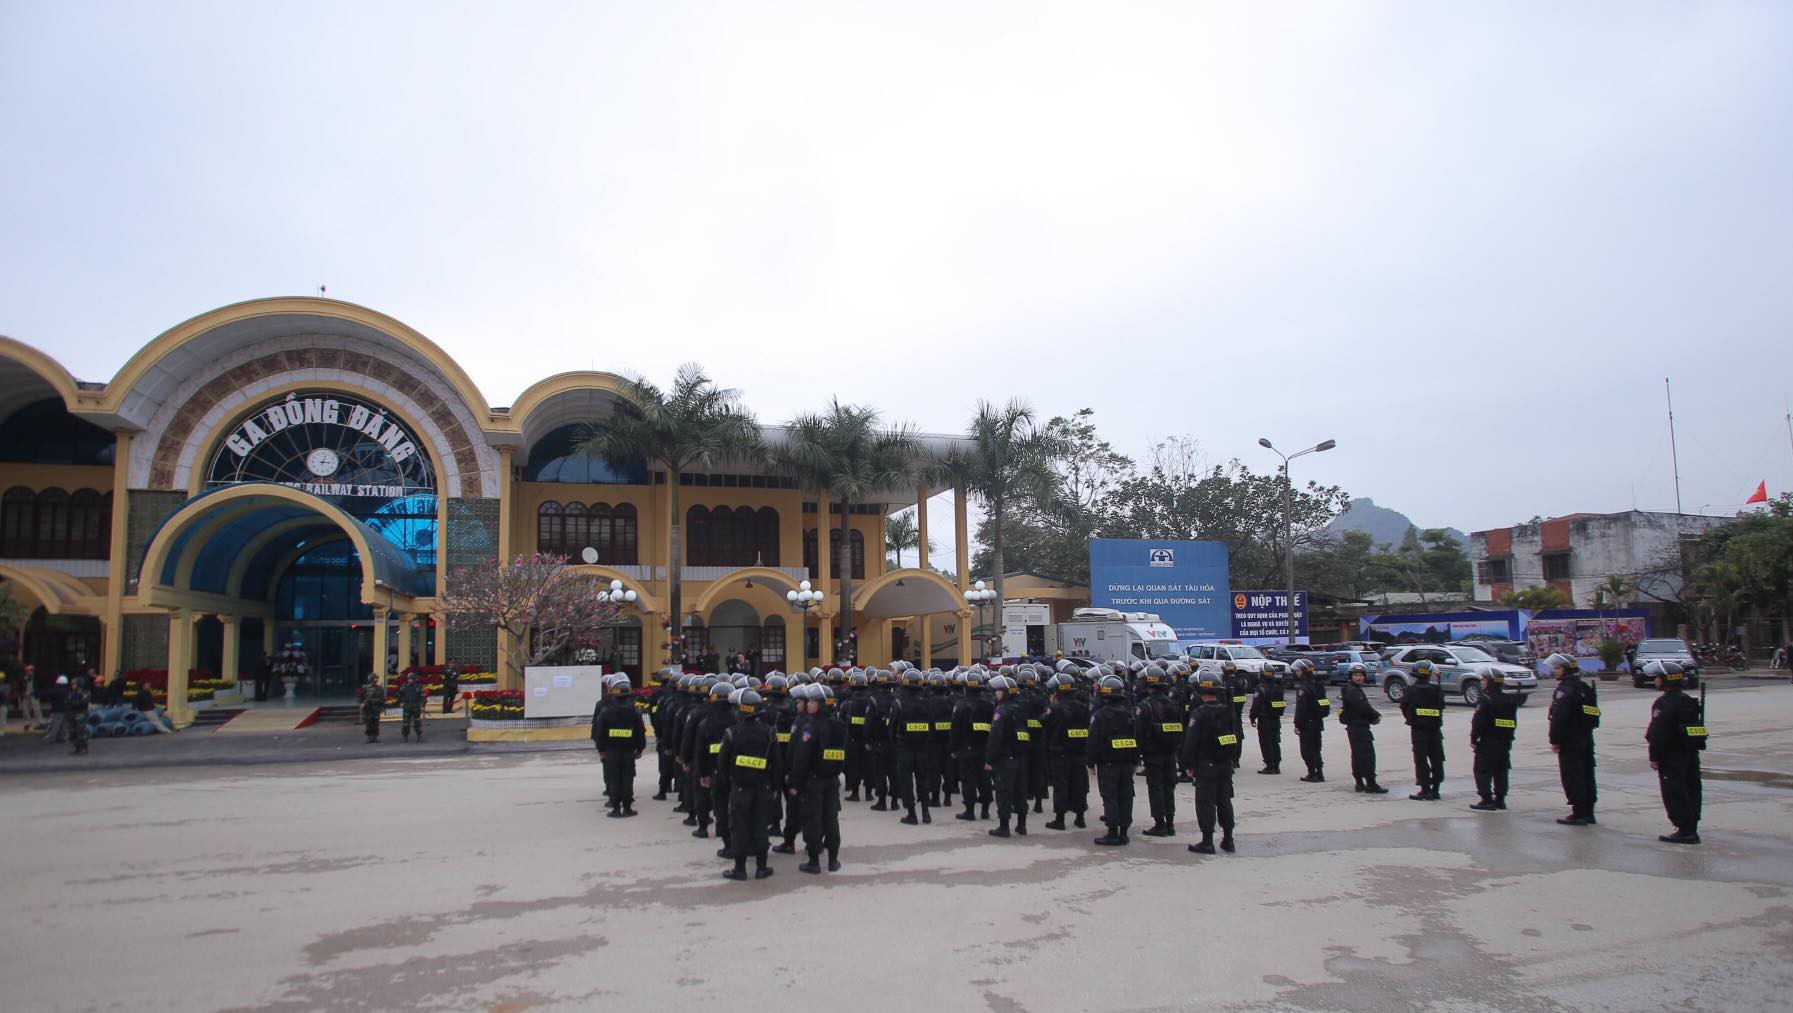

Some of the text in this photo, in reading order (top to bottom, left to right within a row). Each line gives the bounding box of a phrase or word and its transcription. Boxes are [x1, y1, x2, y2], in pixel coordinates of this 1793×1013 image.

[226, 420, 268, 457] GA
[347, 404, 416, 463] ĐĂNG
[305, 483, 352, 496] RAILWAY
[357, 484, 402, 497] STATION
[1132, 585, 1144, 593] LẠI
[1251, 593, 1301, 609] NỘP THẾ
